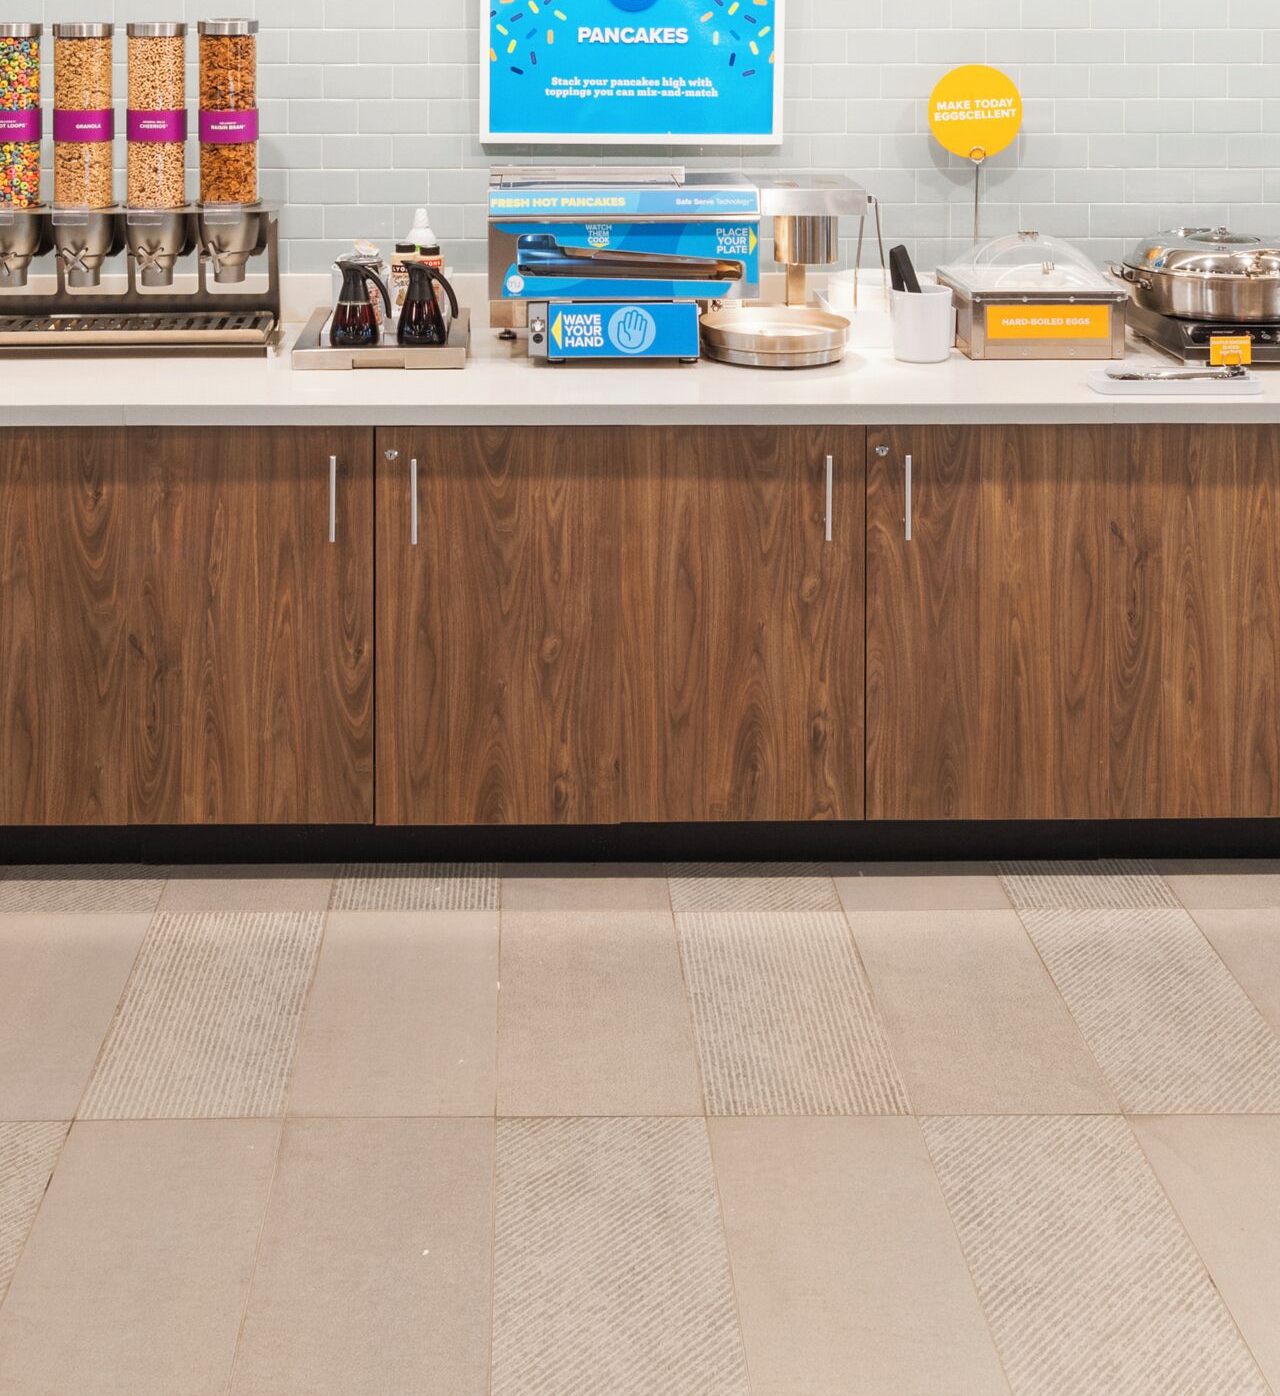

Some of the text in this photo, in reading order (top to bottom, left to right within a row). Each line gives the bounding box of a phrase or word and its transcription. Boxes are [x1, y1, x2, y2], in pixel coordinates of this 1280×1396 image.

[577, 27, 689, 44] PANCAKES
[551, 76, 712, 88] Stack your pancakes high with
[545, 87, 592, 98] toppings
[594, 89, 614, 98] you
[637, 87, 718, 97] mix-and-match
[936, 98, 1014, 111] MAKE TODAY
[934, 108, 1017, 122] EGGSCELLENT
[490, 197, 625, 208] FRESH HOT PANCAKES
[716, 228, 748, 236] PLACE
[717, 236, 746, 245] YOUR
[717, 245, 748, 254] PLATE
[563, 314, 601, 324] WAVE
[1066, 317, 1090, 325] EGGS
[564, 325, 602, 336] YOUR
[565, 337, 604, 347] HAND
